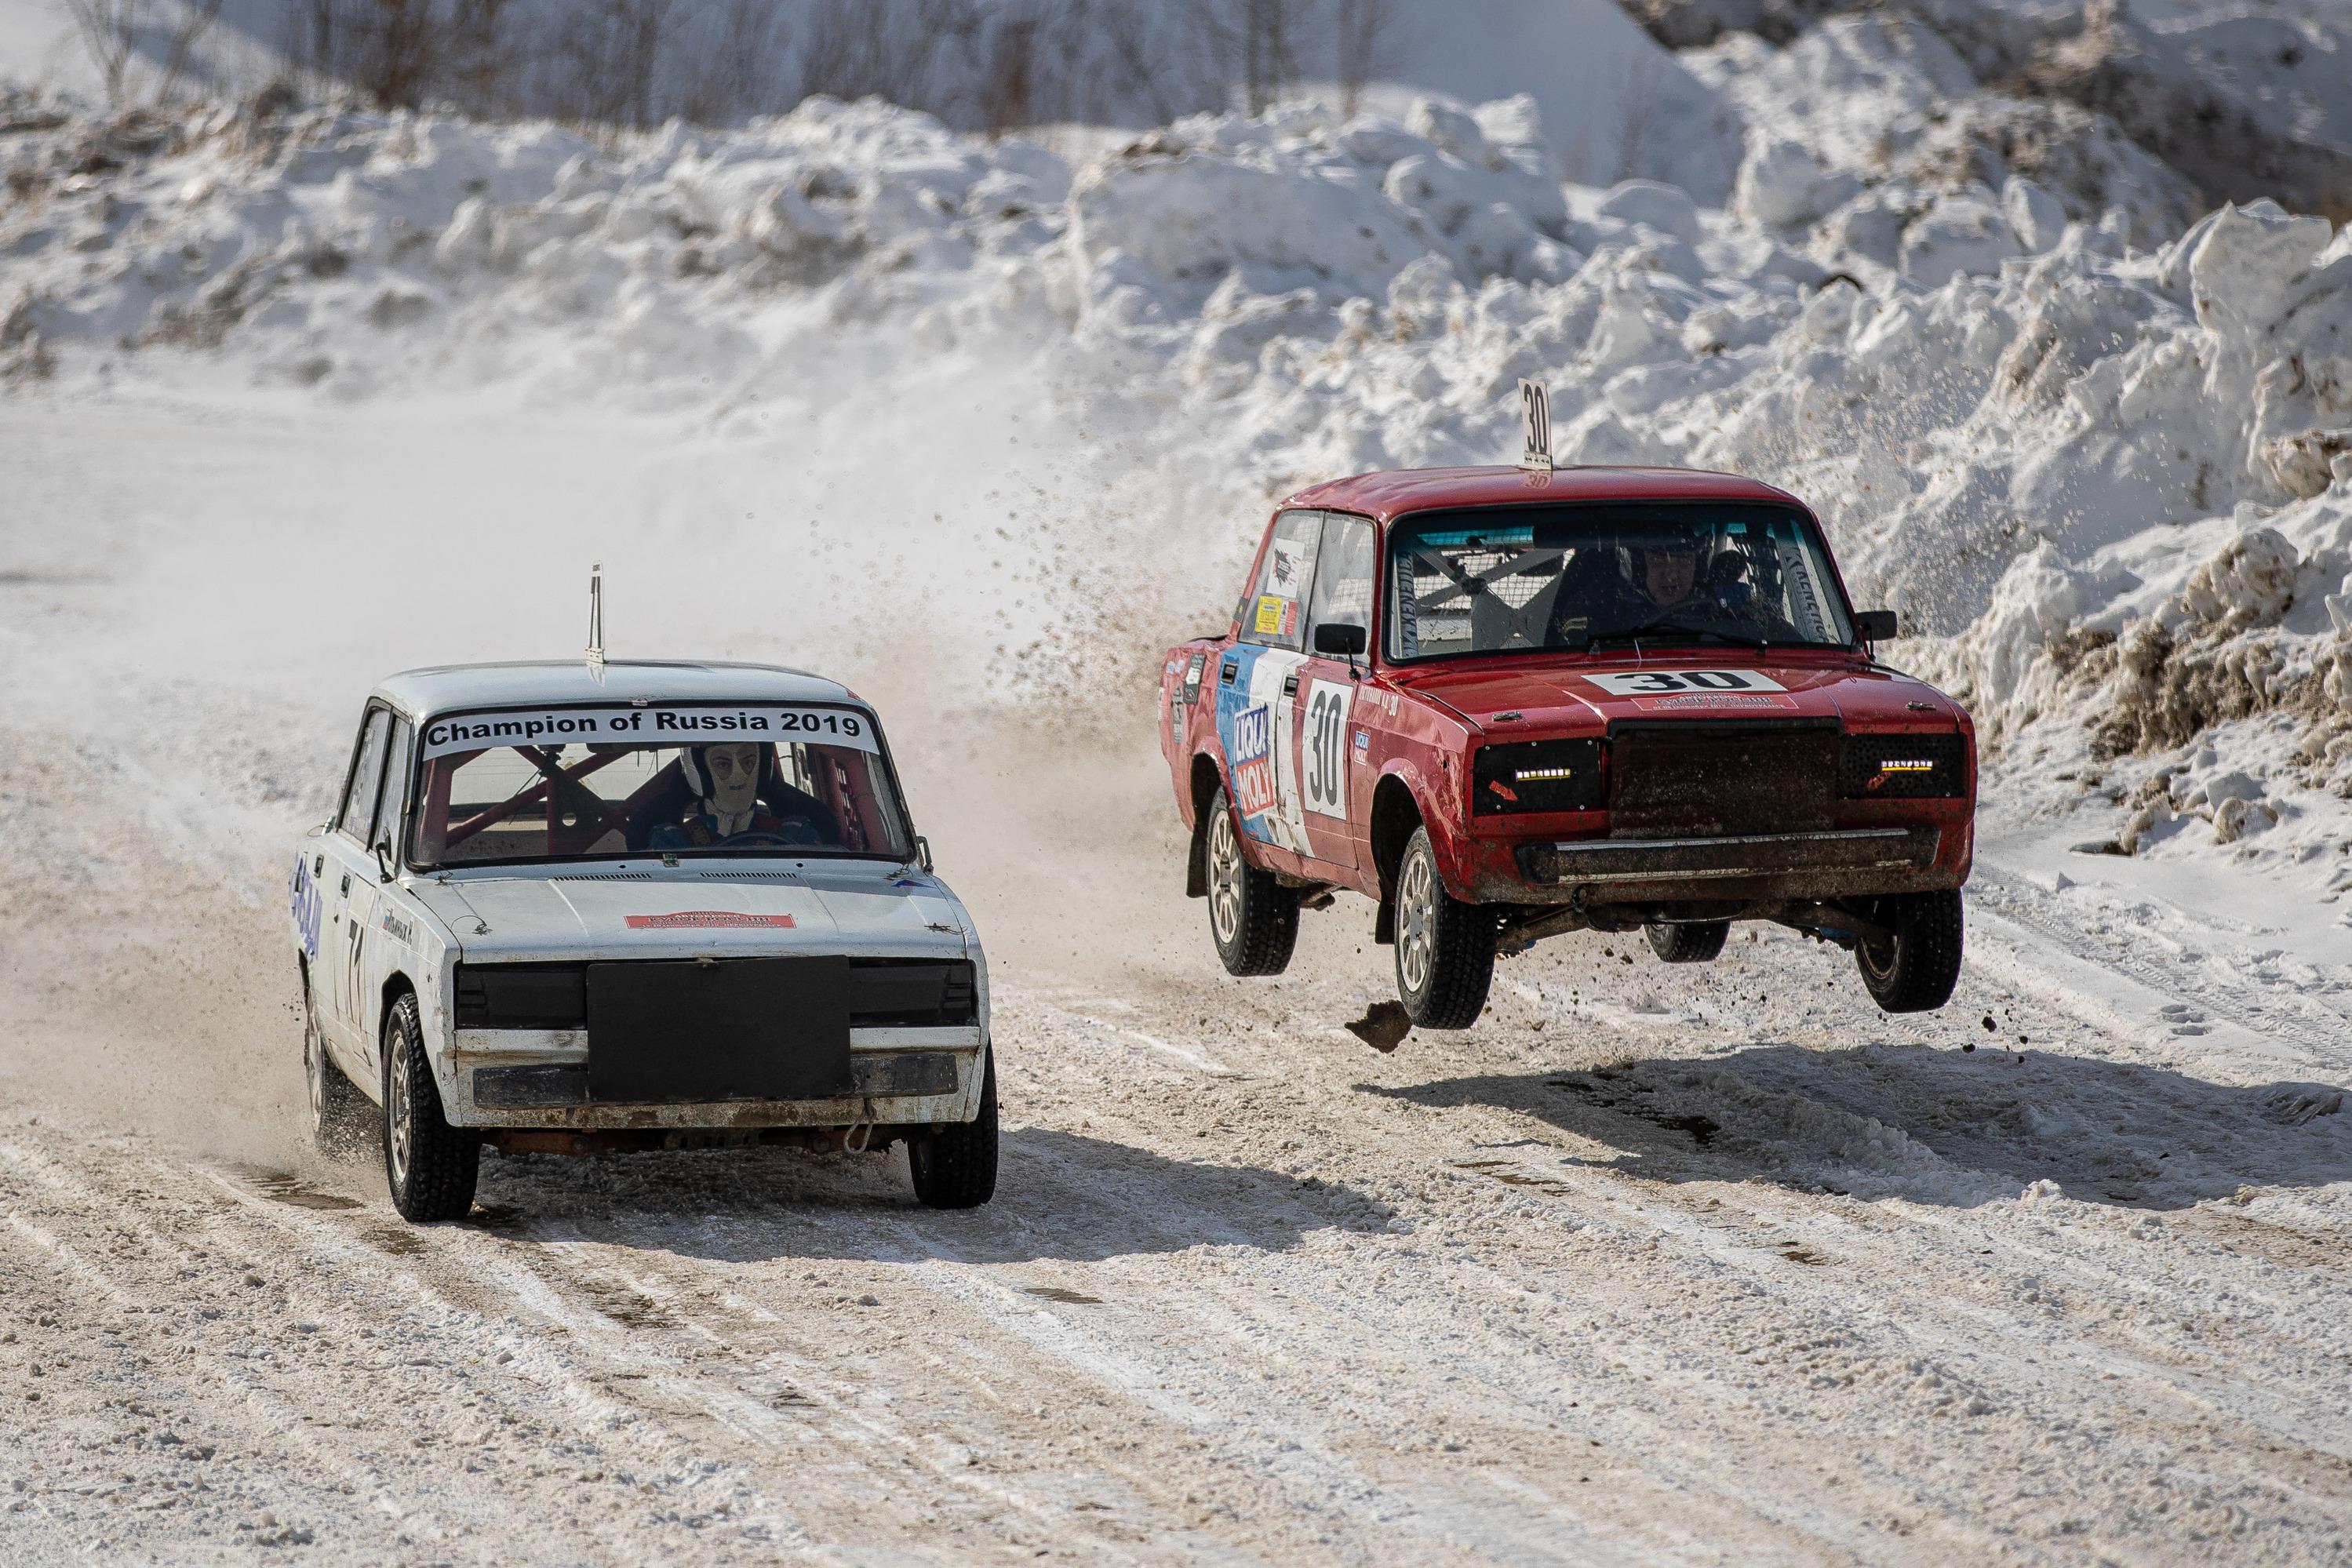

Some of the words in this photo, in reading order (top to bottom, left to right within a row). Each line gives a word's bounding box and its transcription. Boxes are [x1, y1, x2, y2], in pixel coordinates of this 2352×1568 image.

[1524, 383, 1547, 455] 30
[1614, 671, 1753, 691] 30
[427, 715, 597, 747] Champion
[610, 712, 643, 731] of
[656, 711, 769, 730] Russia
[780, 712, 861, 737] 2019
[1309, 690, 1342, 806] 30
[1237, 762, 1271, 812] MOLY
